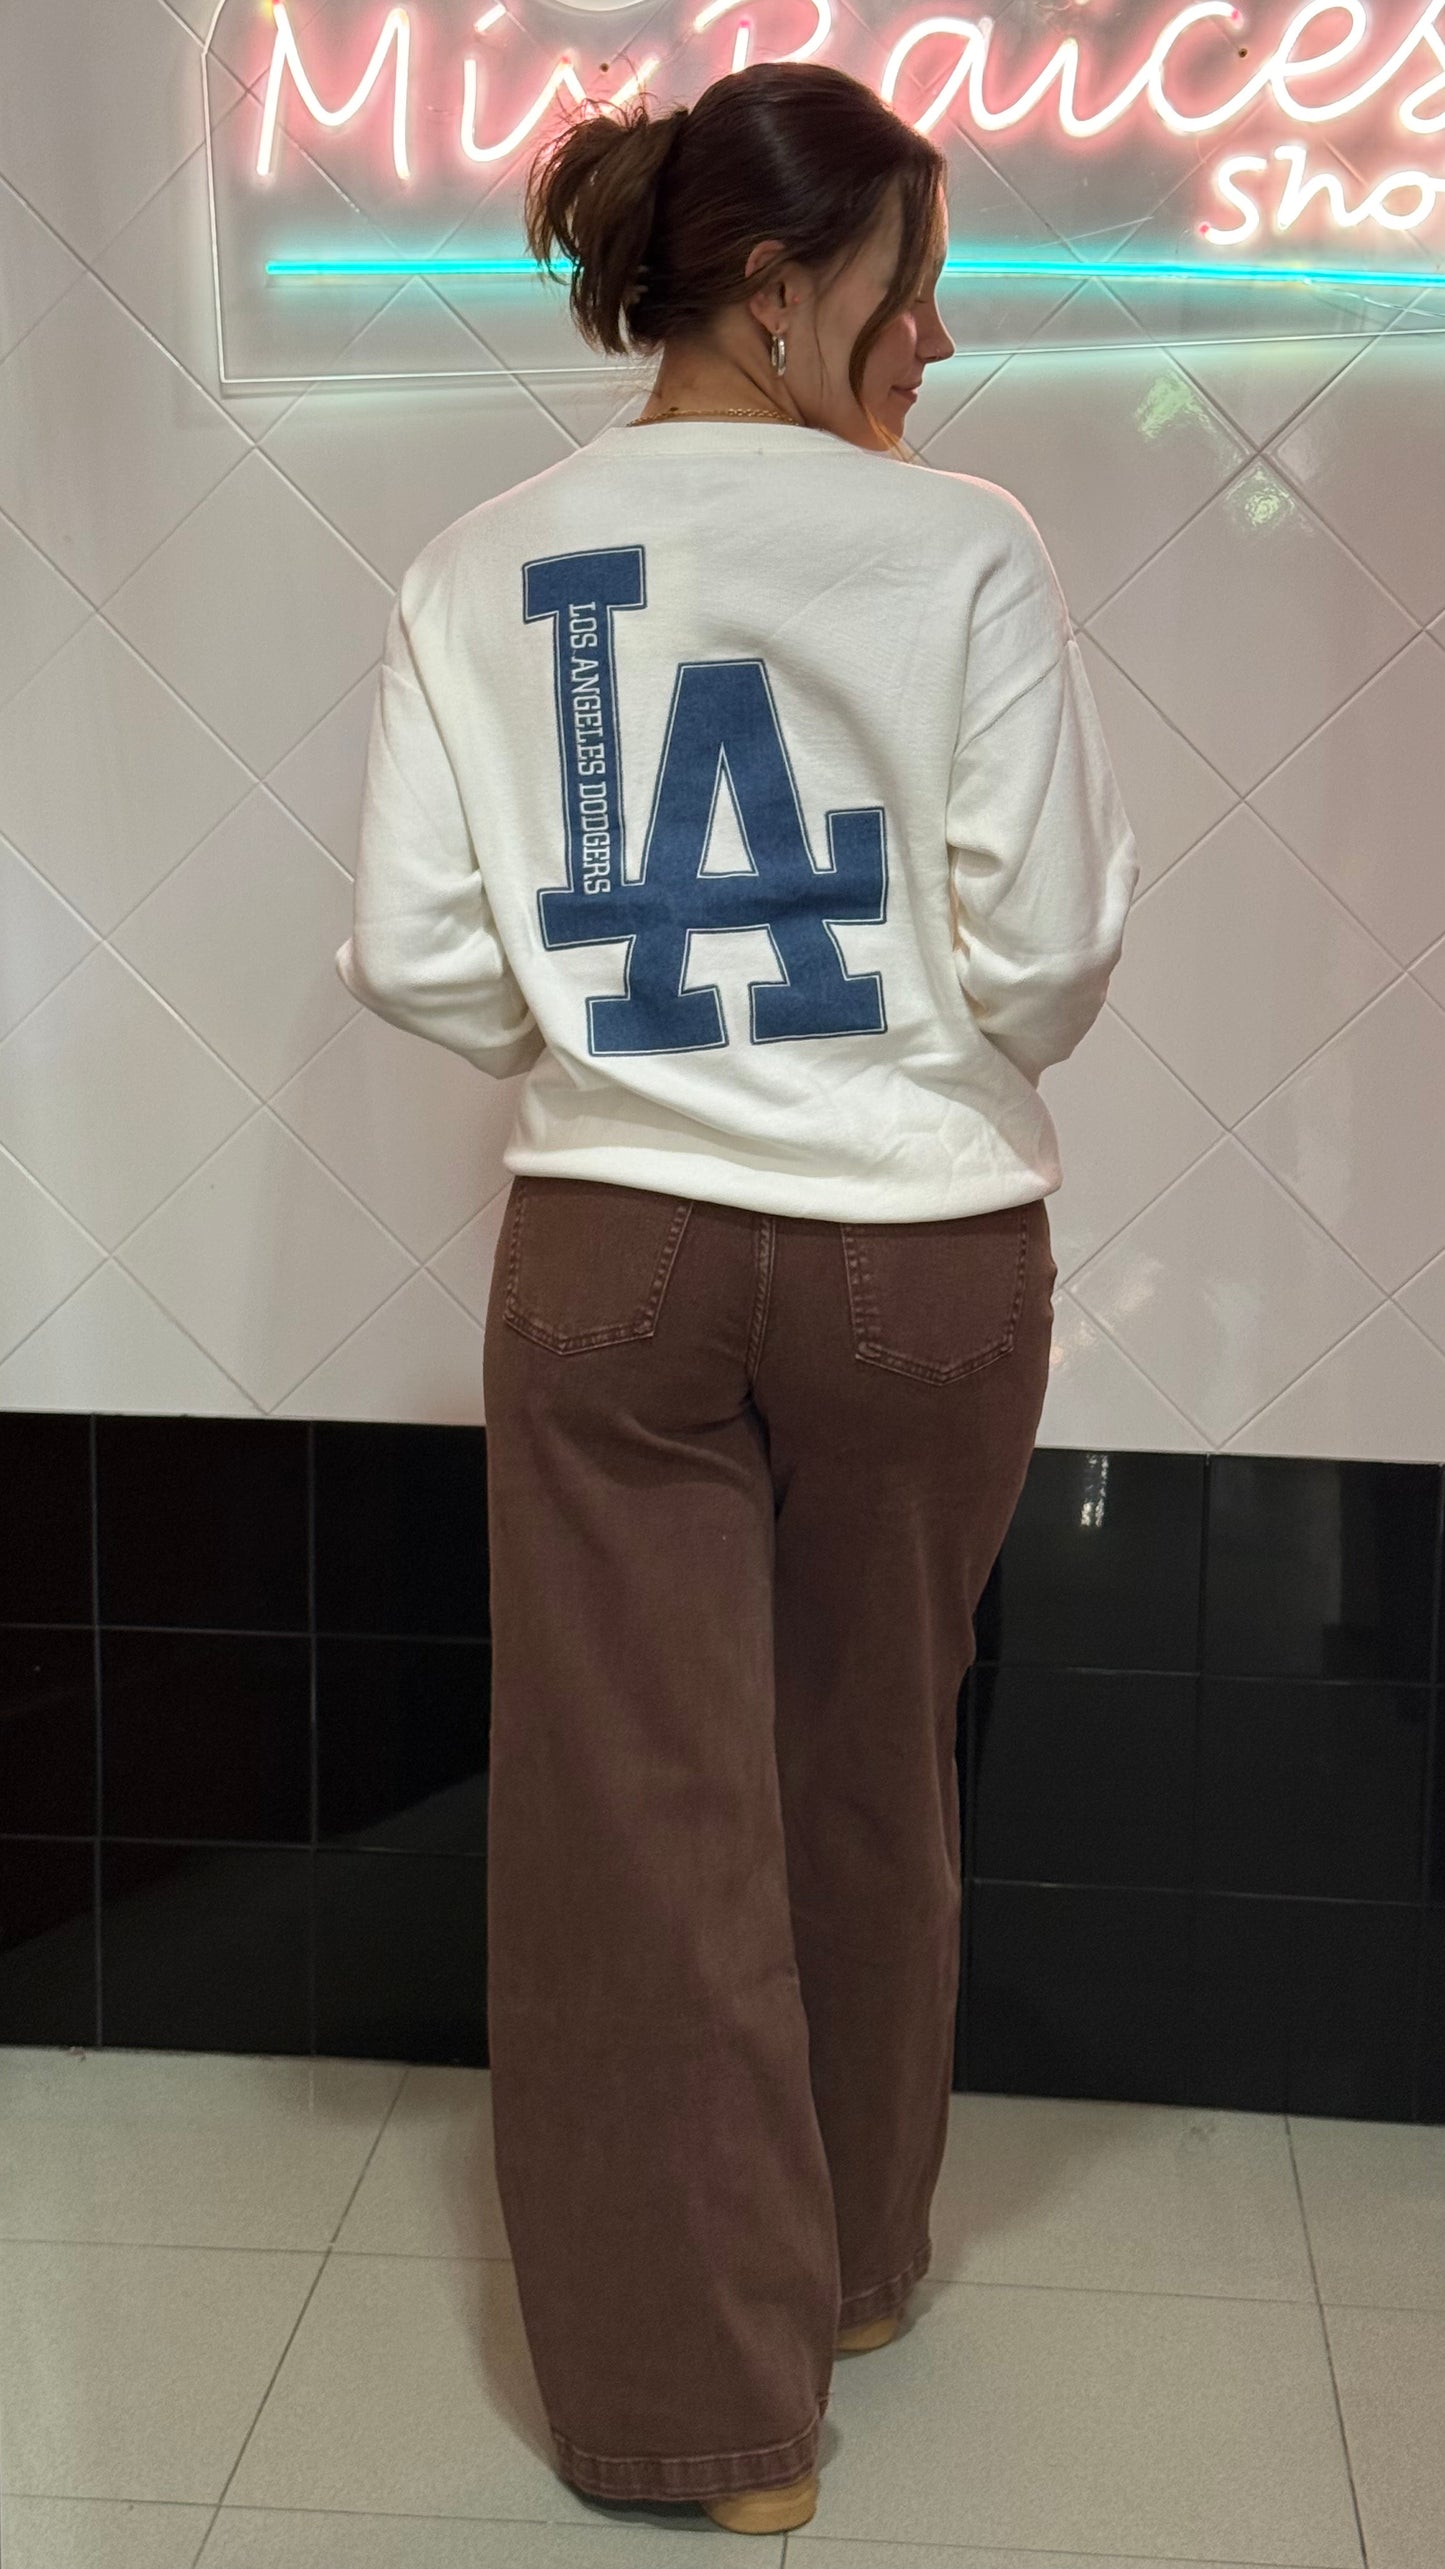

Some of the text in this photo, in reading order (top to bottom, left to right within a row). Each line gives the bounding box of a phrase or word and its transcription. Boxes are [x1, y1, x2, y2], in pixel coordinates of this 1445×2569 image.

[522, 544, 888, 1056] LA
[568, 601, 611, 895] LOS ANGELES DODGERS
